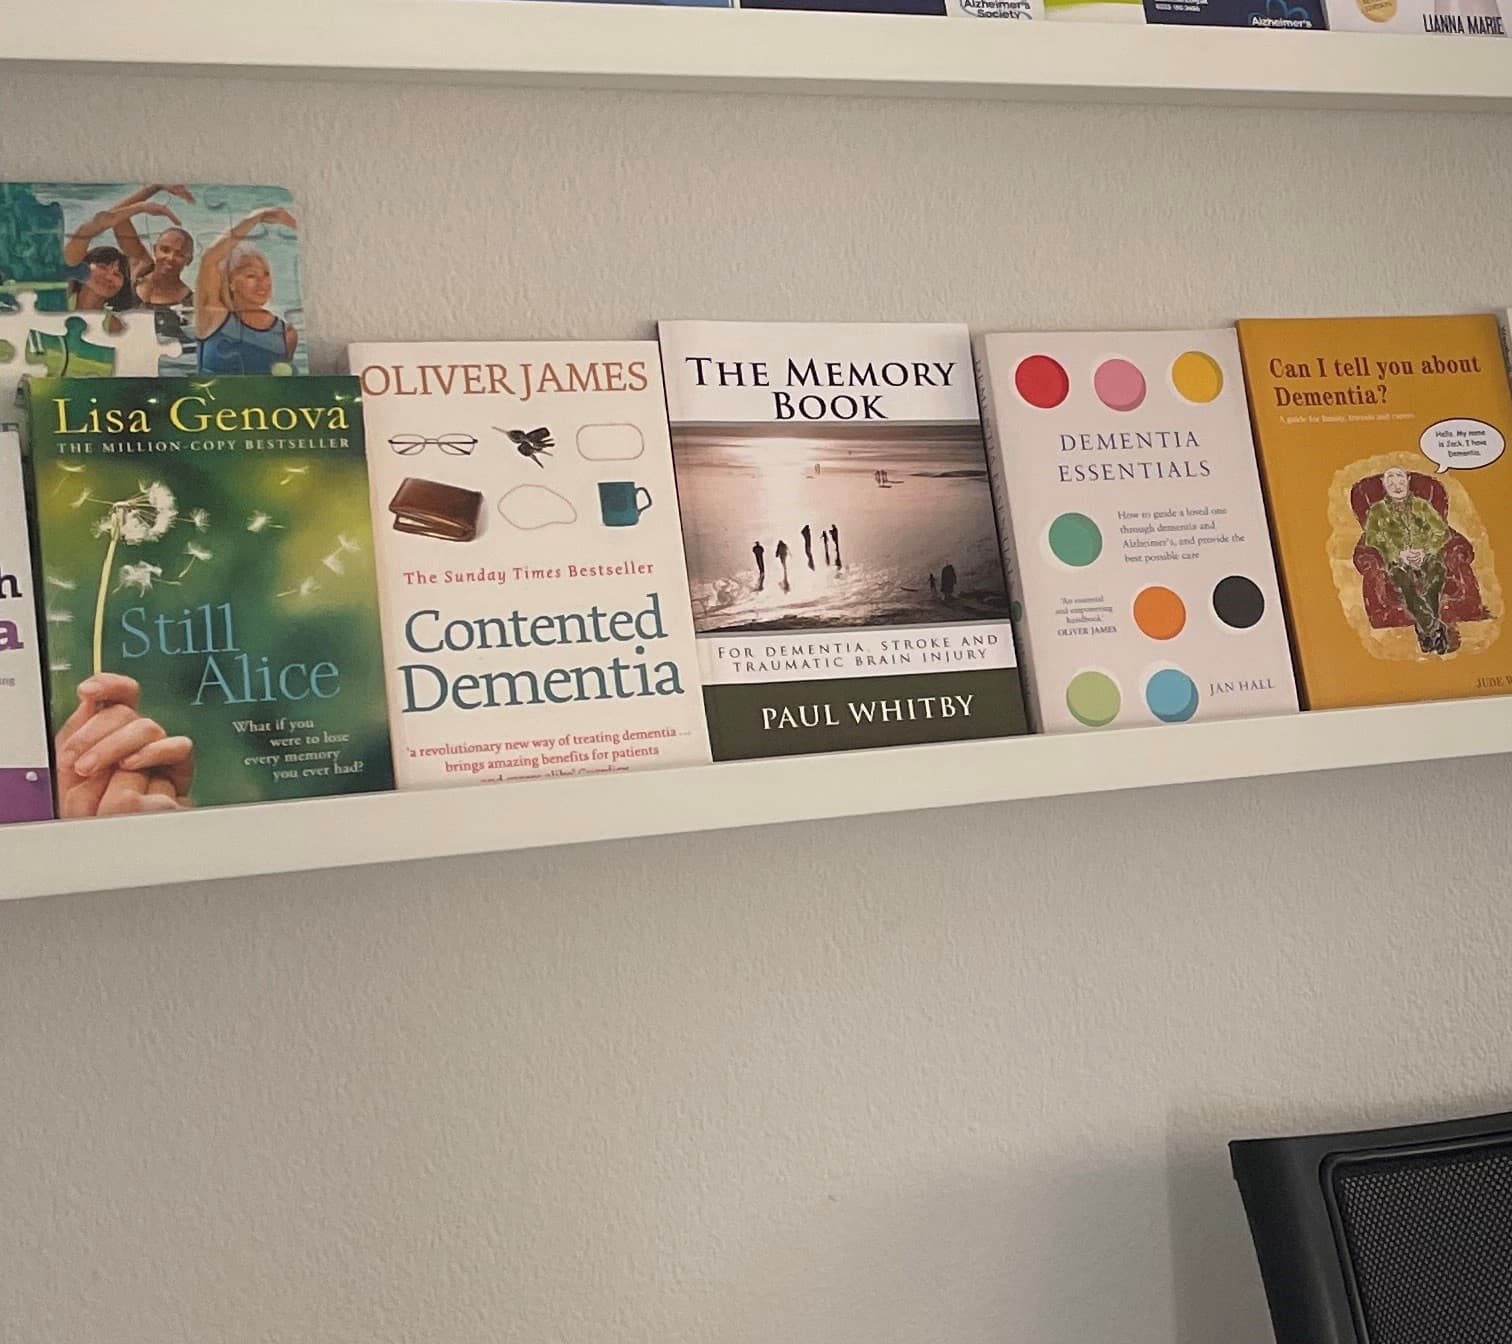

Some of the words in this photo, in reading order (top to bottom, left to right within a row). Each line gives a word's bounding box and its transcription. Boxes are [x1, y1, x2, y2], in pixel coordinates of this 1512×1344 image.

[1423, 14, 1464, 34] LIANNA
[1467, 16, 1504, 35] MARIE
[686, 357, 769, 387] THE
[788, 357, 957, 387] MEMORY
[1269, 358, 1311, 378] Can
[1317, 358, 1328, 377] I
[1334, 357, 1369, 376] tell
[1376, 359, 1413, 380] you
[1422, 355, 1481, 374] about
[361, 365, 517, 397] OLIVER
[520, 362, 648, 400] JAMES
[772, 391, 888, 420] BOOK
[1274, 385, 1387, 406] Dementia?
[52, 397, 150, 434] Lisa
[169, 396, 349, 432] Genova
[57, 443, 93, 454] THE
[246, 438, 349, 449] BESTSELLER
[1060, 431, 1200, 452] DEMENTIA
[1058, 460, 1210, 482] ESSENTIALS
[403, 572, 437, 585] The
[444, 568, 506, 584] Sunday
[513, 567, 561, 580] Times
[569, 560, 654, 577] Bestseller
[122, 603, 240, 657] Still
[405, 593, 667, 654] Contented
[718, 646, 753, 659] FOR
[881, 637, 950, 651] STROKE
[961, 634, 999, 646] AND
[733, 657, 844, 673] TRAUMATIC
[855, 653, 911, 667] BRAIN
[922, 649, 988, 664] INJURY
[190, 655, 341, 706] Alice
[398, 646, 684, 712] Dementia
[1210, 681, 1234, 696] JAN
[1240, 679, 1274, 692] HALL
[761, 705, 840, 730] PAUL
[848, 694, 976, 724] WHITBY
[232, 720, 270, 733] What
[276, 718, 285, 730] if
[289, 720, 314, 732] you
[270, 737, 301, 747] were
[306, 736, 319, 744] to
[323, 731, 350, 743] lose
[419, 742, 501, 756] revolutionary
[505, 740, 528, 749] new
[532, 739, 555, 749] way
[559, 734, 571, 746] of
[574, 732, 620, 746] treating
[622, 727, 676, 741] dementia
[244, 756, 280, 767] every
[285, 750, 341, 762] memory
[273, 769, 298, 780] you
[303, 766, 329, 776] ever
[334, 761, 364, 774] had?
[445, 758, 485, 773] brings
[487, 756, 539, 769] amazing
[542, 750, 589, 764] benefits
[592, 748, 608, 760] for
[612, 746, 659, 762] patients
